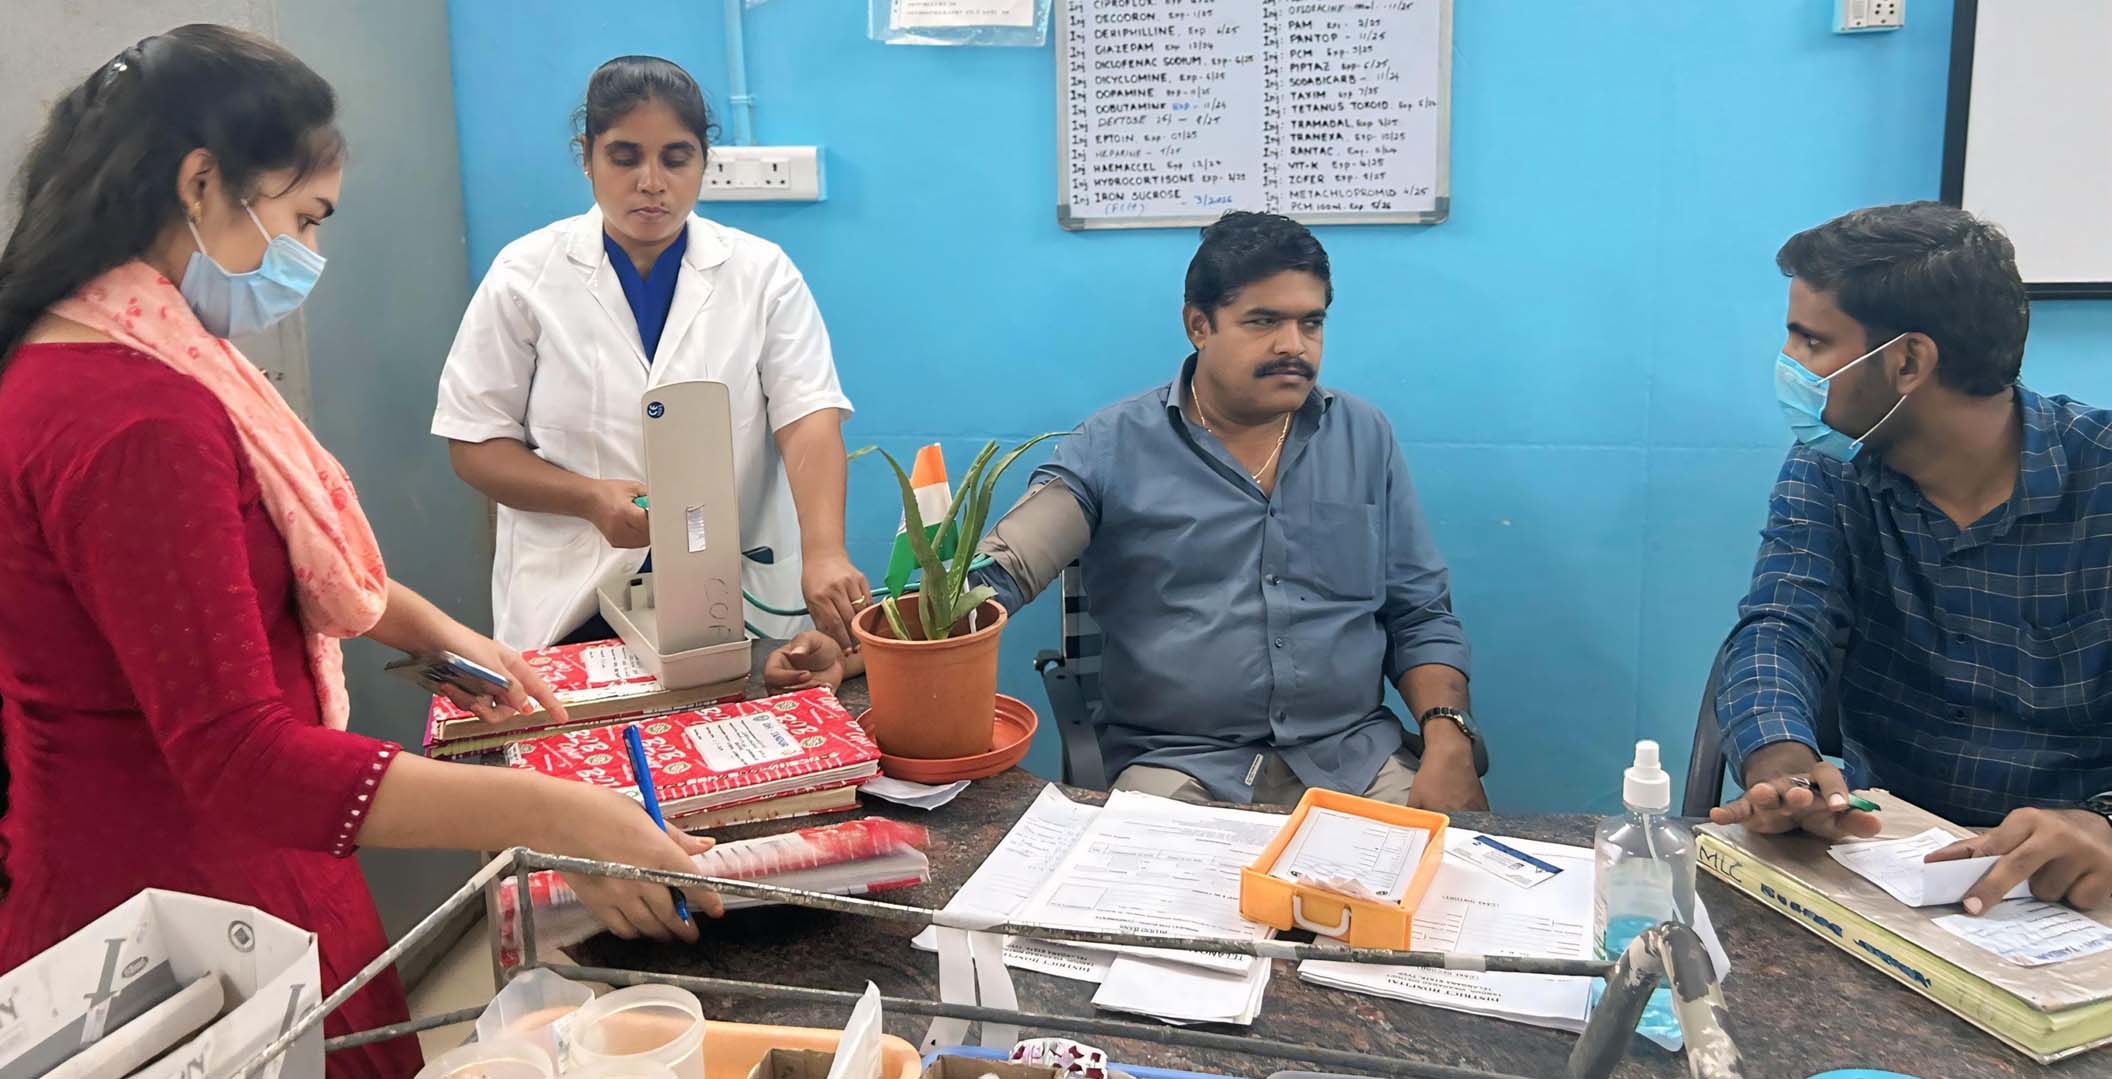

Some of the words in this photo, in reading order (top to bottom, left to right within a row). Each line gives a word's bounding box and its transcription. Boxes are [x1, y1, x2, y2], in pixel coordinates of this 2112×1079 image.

[1288, 20, 1313, 30] PAM
[1290, 49, 1313, 59] PCM
[1292, 101, 1344, 113] TETANUS
[1095, 191, 1125, 203] IRON
[1131, 189, 1182, 201] SUCROSE
[1699, 846, 1743, 883] MLC
